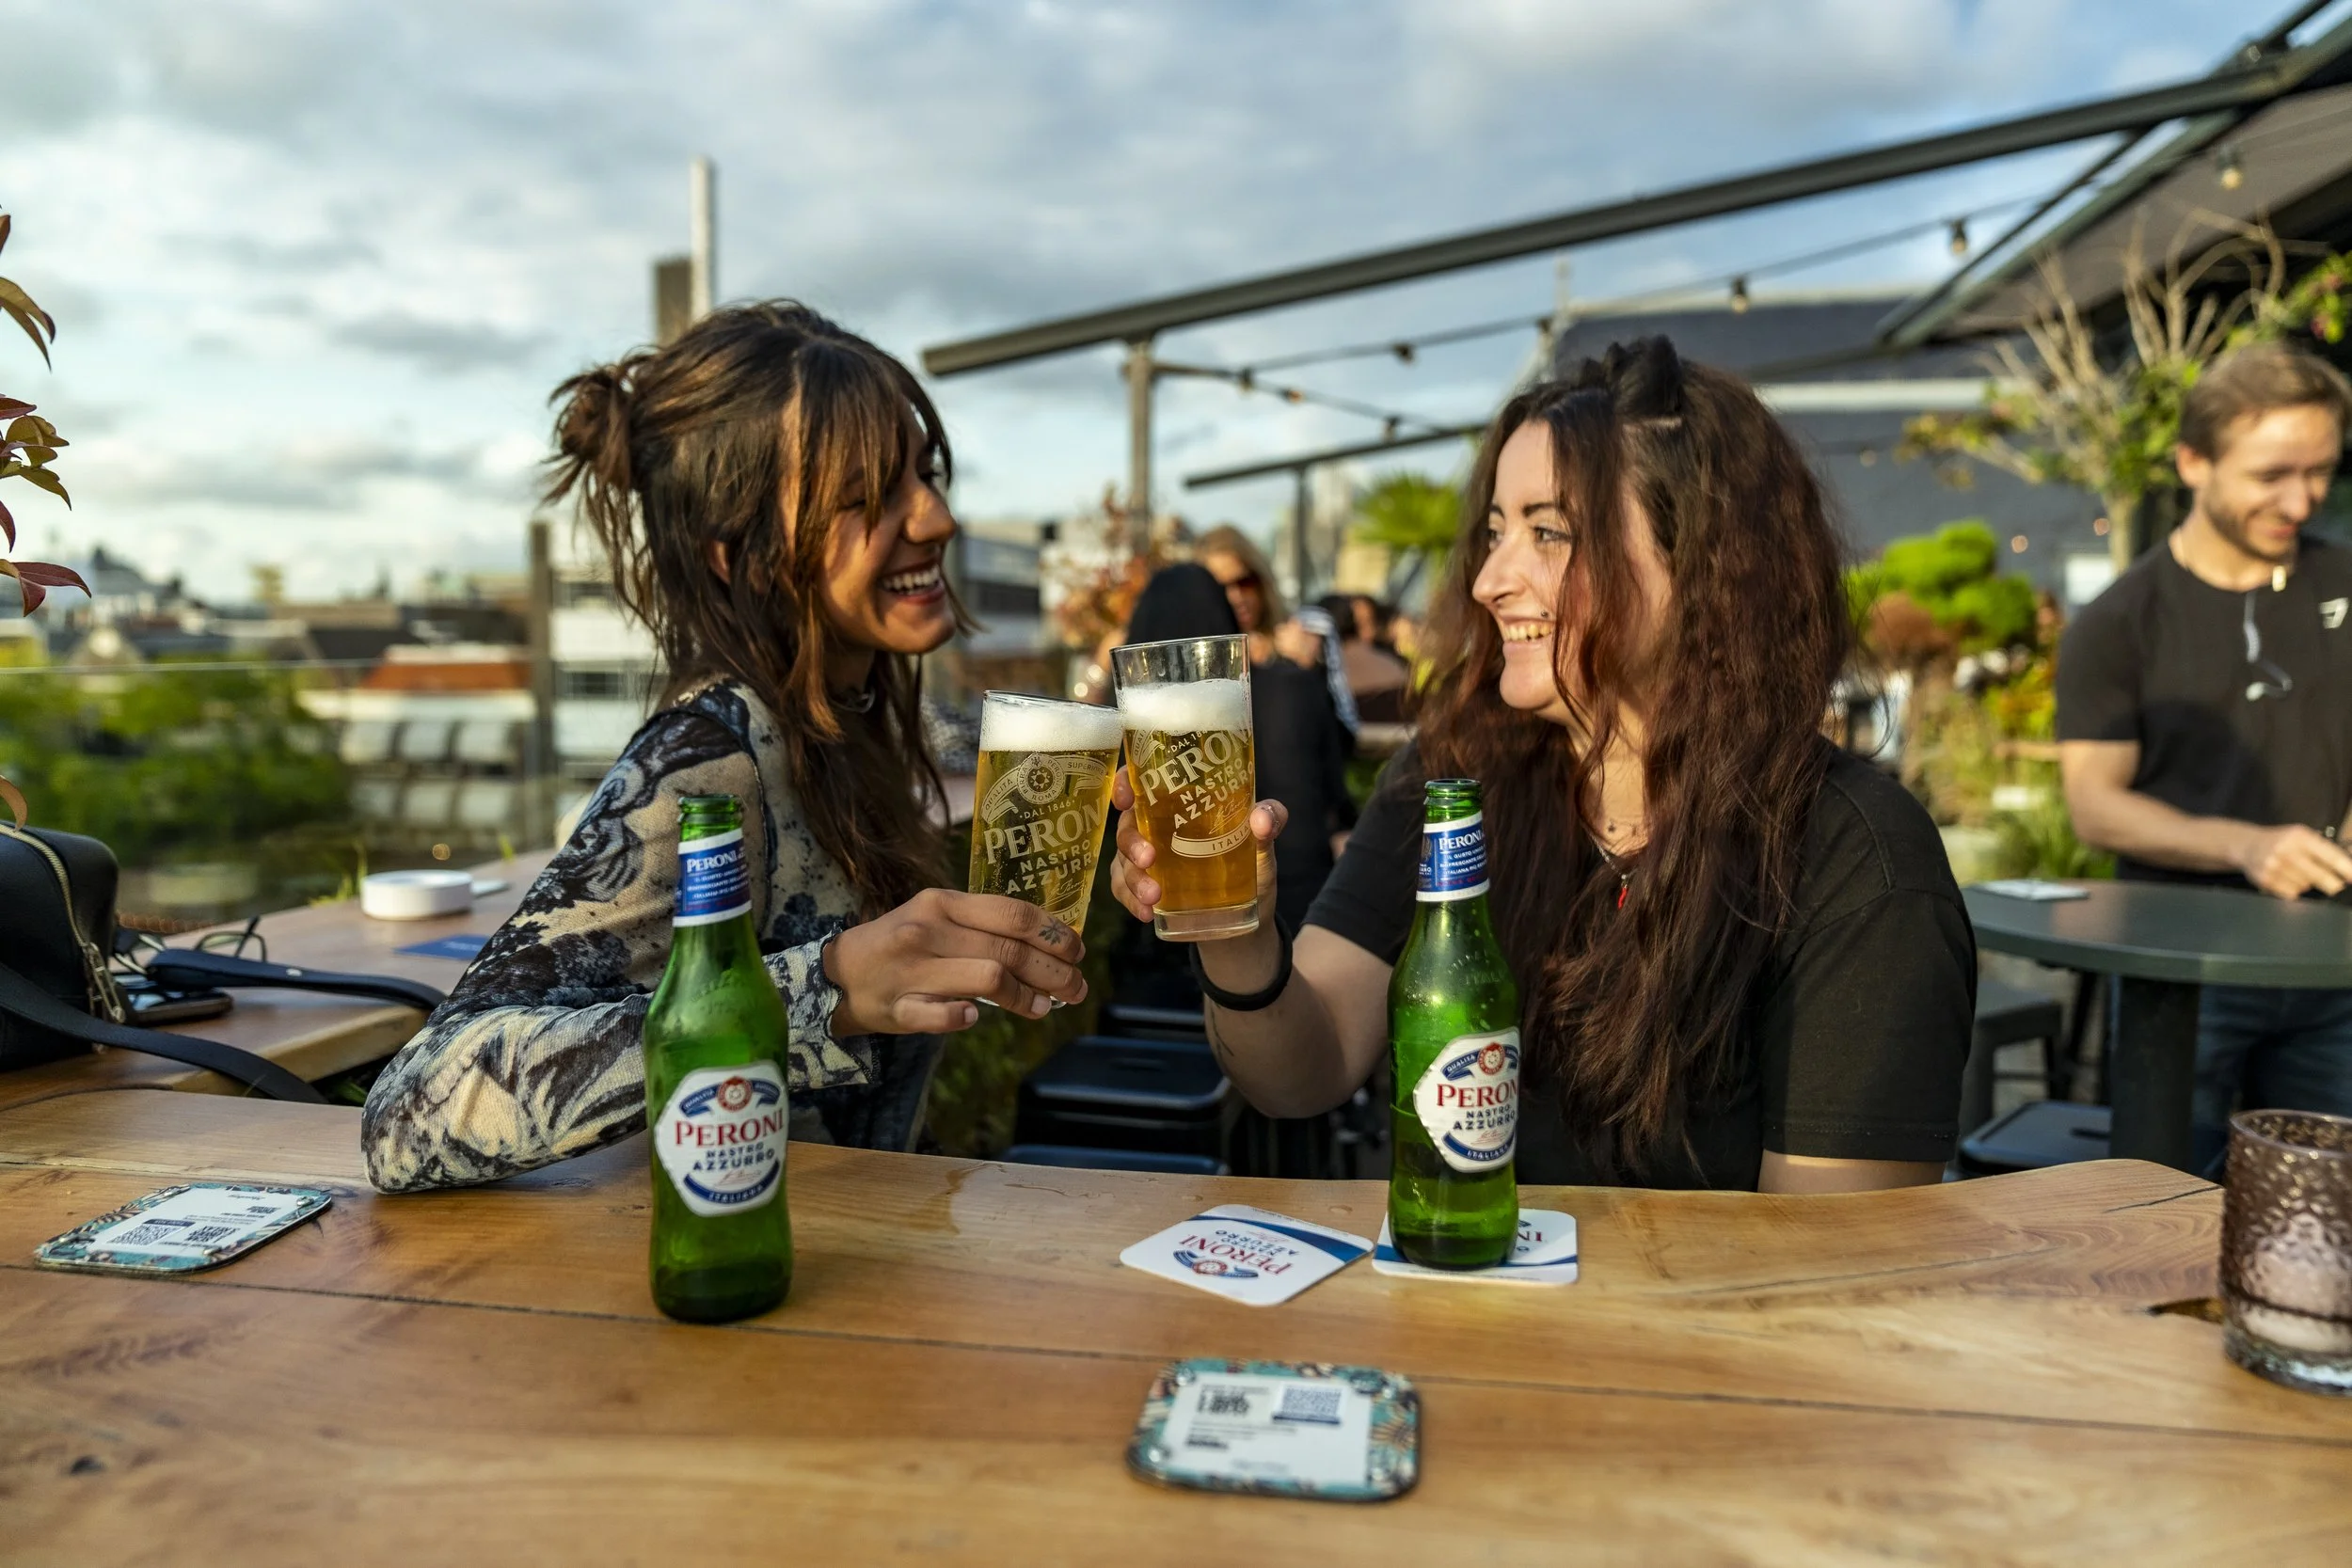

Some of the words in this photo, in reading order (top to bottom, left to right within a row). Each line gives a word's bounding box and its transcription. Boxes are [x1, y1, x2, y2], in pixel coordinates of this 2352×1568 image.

[1170, 737, 1190, 752] DAL
[1138, 730, 1252, 807] PERON
[1179, 757, 1243, 805] NASTRO
[1031, 789, 1057, 801] ROMA
[1173, 761, 1254, 830] AZZURRO
[1024, 809, 1045, 820] DAL
[1047, 799, 1072, 814] 1846
[1438, 830, 1482, 850] PERONI
[686, 850, 738, 873] PERONI
[1007, 844, 1100, 895] AZZURRO
[1020, 839, 1091, 875] NASTRO
[1436, 1078, 1518, 1108] PERON
[1453, 1111, 1516, 1131] AZZURRO
[1466, 1103, 1511, 1118] NASTRO
[675, 1107, 785, 1148] PERONI
[692, 1148, 775, 1171] AZZURRO
[706, 1141, 764, 1159] NASTRO
[1179, 1235, 1294, 1275] PERONI
[1215, 1229, 1299, 1257] AZZURRO
